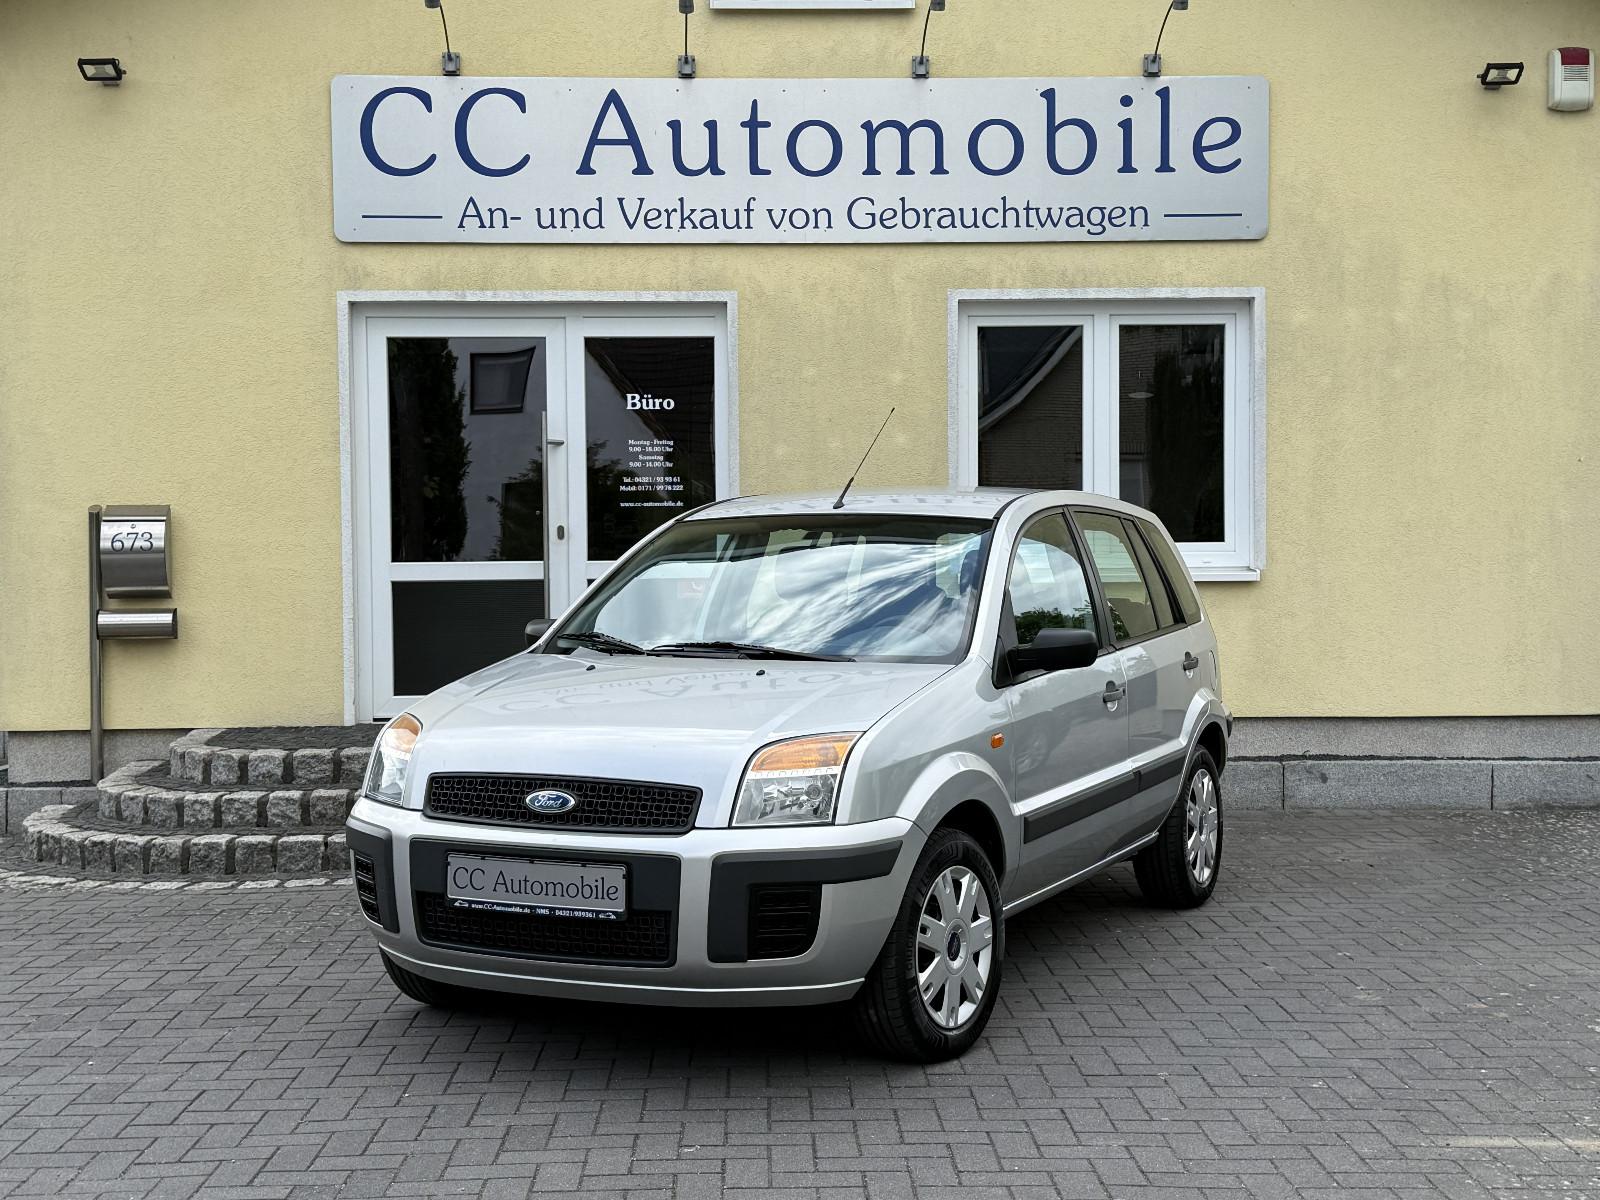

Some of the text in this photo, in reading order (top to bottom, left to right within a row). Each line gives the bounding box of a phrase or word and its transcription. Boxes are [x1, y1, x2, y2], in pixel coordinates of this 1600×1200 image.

[359, 86, 1242, 177] CC Automobile
[456, 196, 1150, 236] An- und Verkauf von Gebrauchtwagen
[626, 393, 675, 410] Büro
[110, 531, 154, 552] 673
[452, 866, 619, 901] CC Automobile
